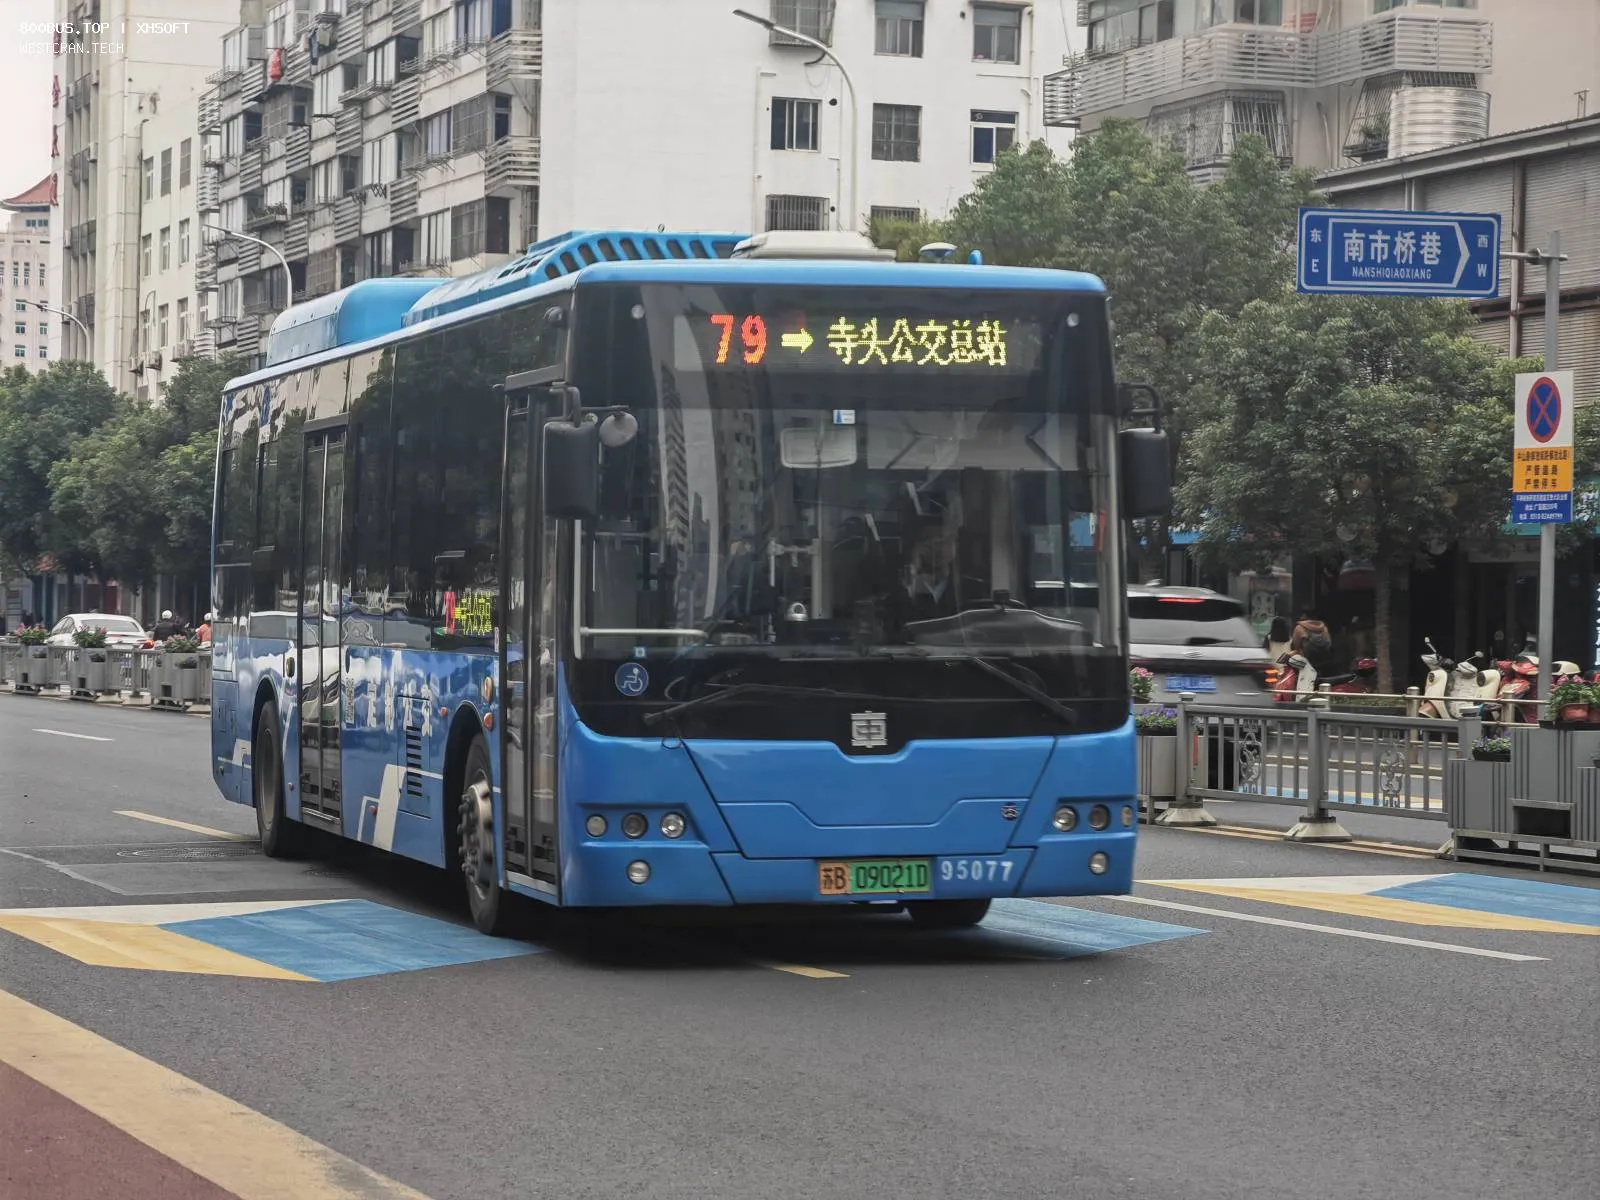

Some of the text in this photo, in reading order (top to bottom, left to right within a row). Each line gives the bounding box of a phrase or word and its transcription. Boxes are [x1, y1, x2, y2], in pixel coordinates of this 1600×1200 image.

[1310, 228, 1322, 243] 东
[1477, 234, 1489, 249] 西
[1343, 228, 1442, 266] 南市桥巷
[1311, 258, 1320, 273] E
[1477, 263, 1488, 278] W
[1351, 267, 1432, 280] NANSHIQIAOXIANG
[710, 314, 1007, 366] 79 寺头公交总站
[855, 863, 928, 889] 09021D
[940, 860, 1014, 882] 95077
